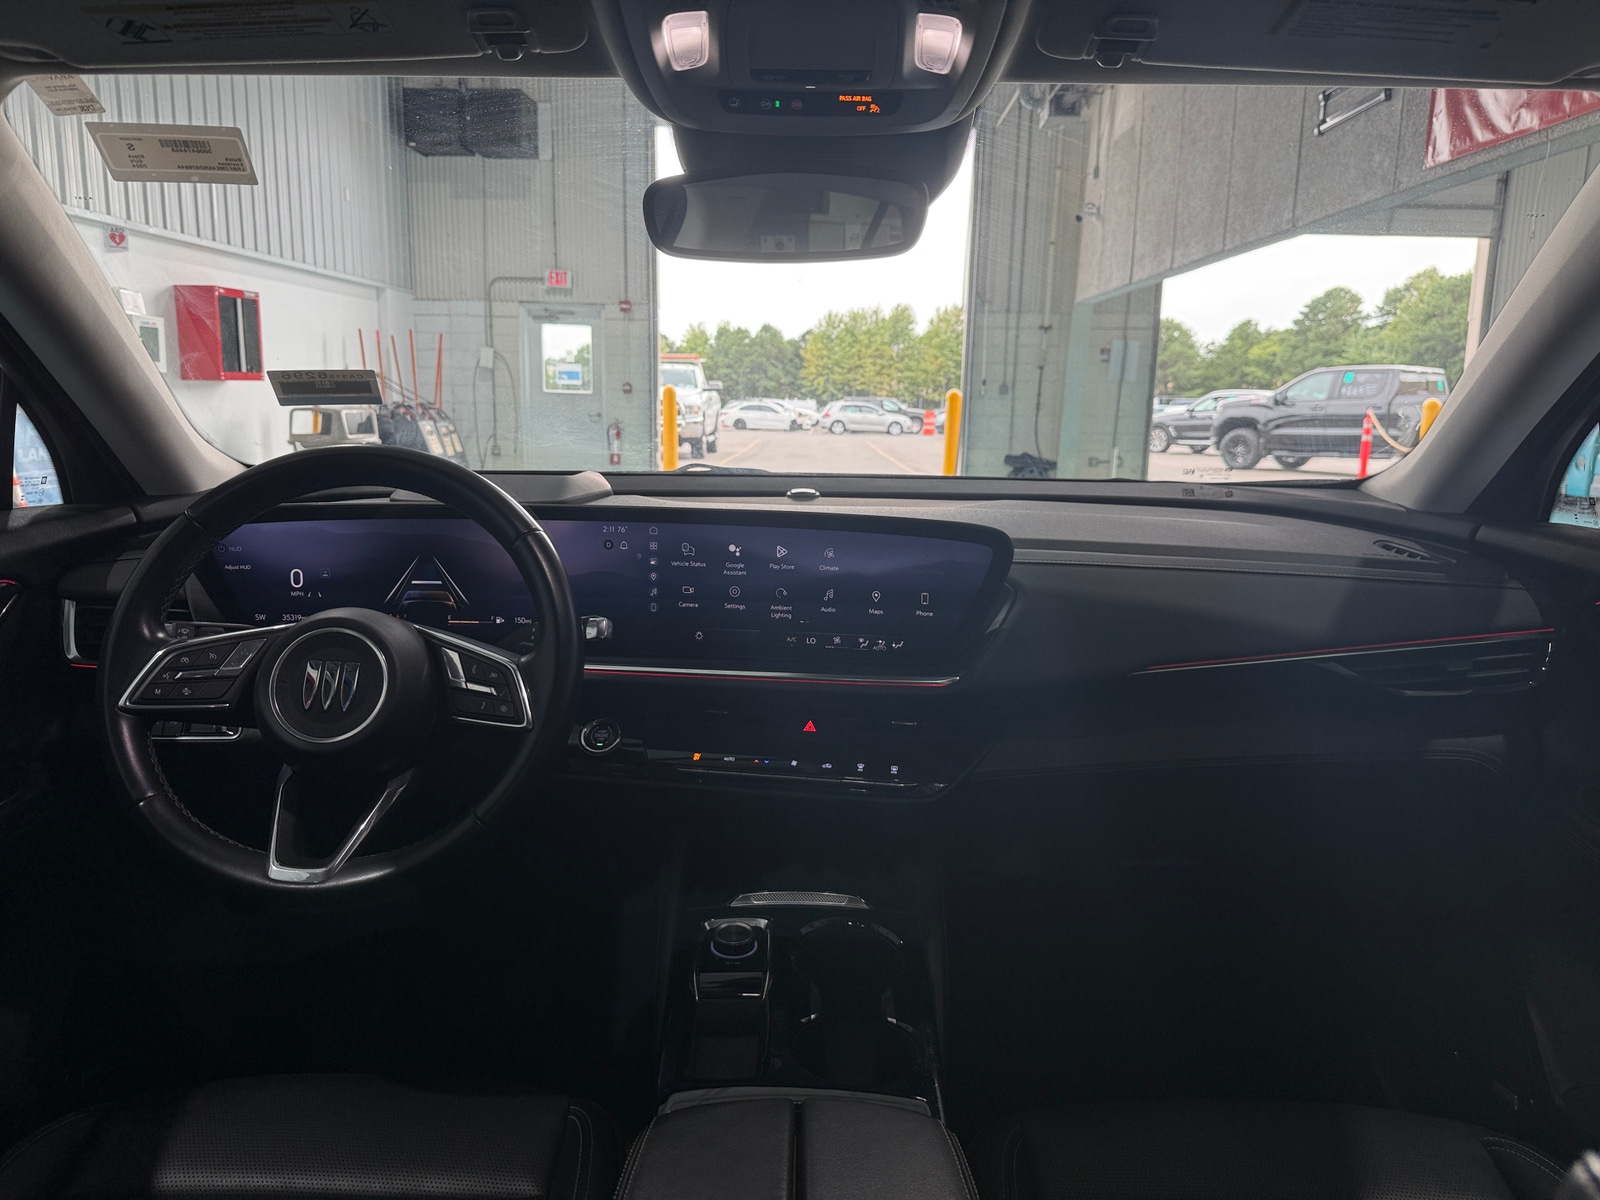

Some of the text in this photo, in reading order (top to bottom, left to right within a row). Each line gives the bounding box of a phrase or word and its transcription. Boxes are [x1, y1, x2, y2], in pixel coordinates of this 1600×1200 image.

[548, 269, 567, 287] EXIT
[290, 568, 303, 588] 0
[724, 602, 746, 610] Settings
